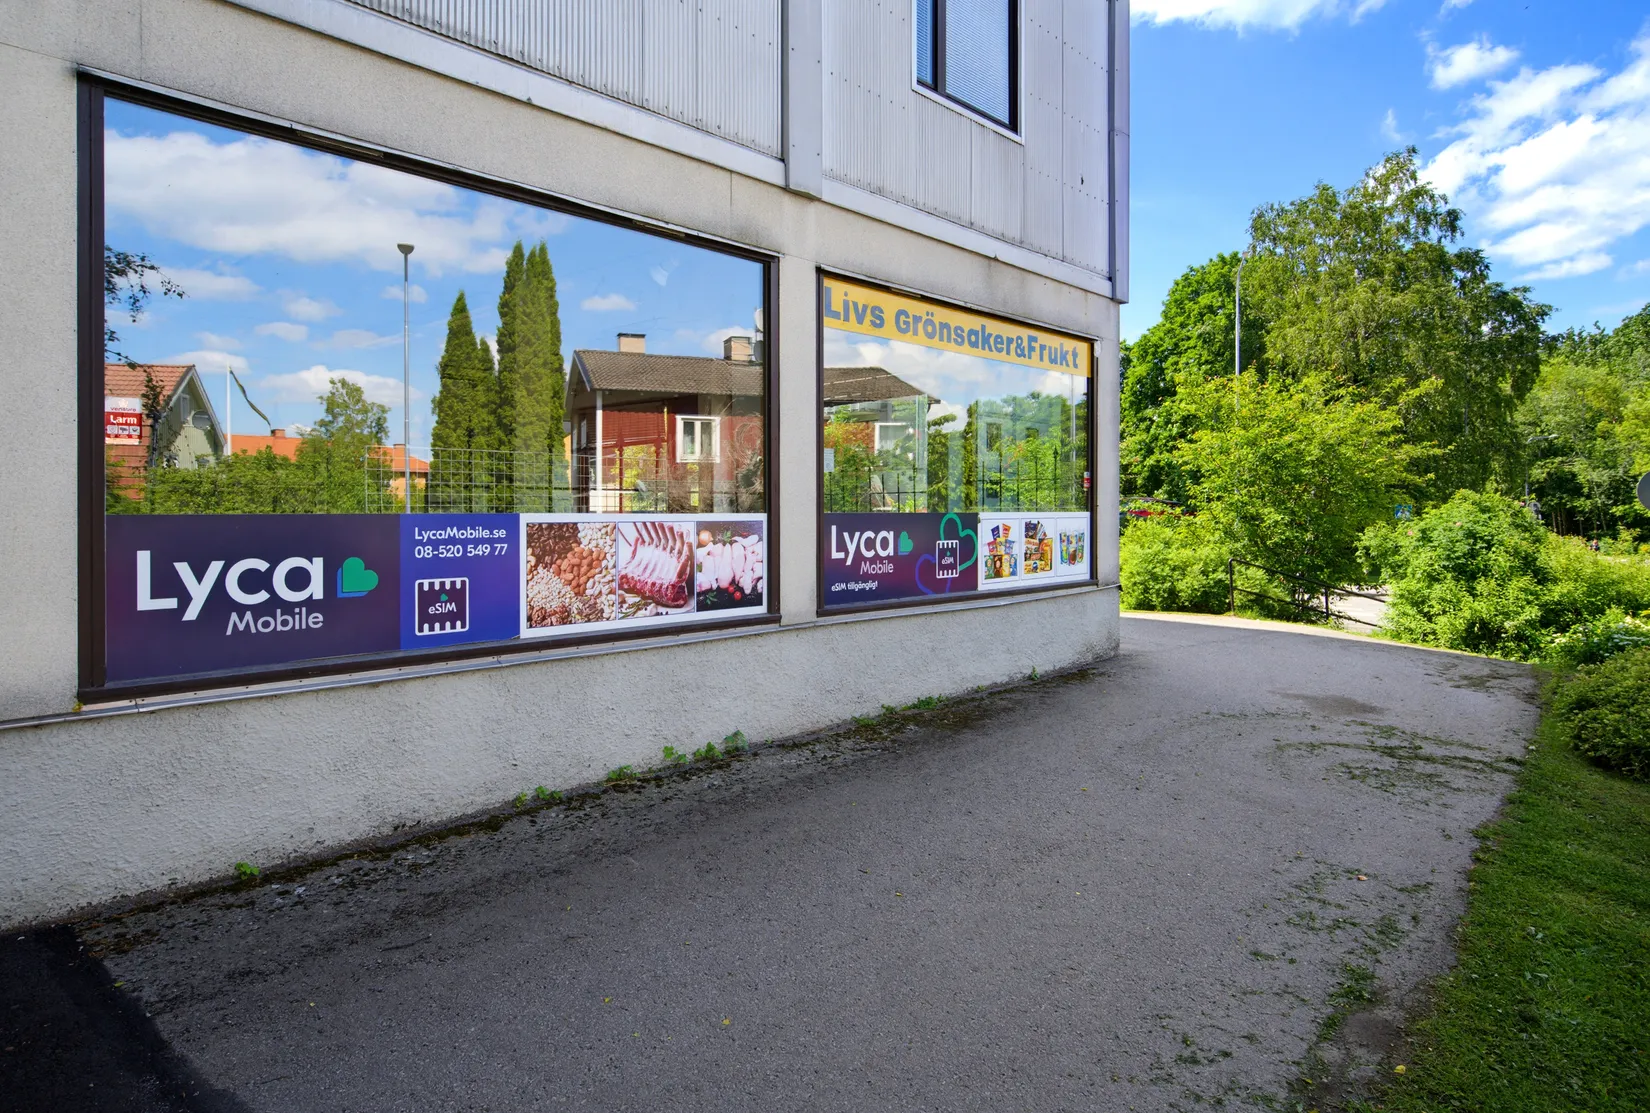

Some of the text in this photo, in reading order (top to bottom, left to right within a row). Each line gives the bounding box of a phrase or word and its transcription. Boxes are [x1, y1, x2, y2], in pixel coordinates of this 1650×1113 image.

[824, 286, 1079, 369] Livs Grönsaker&Frukt
[110, 415, 137, 424] Larm
[415, 526, 507, 543] LycaMobile.se
[415, 543, 508, 559] 08-520 549 77
[831, 525, 894, 566] Lyca
[860, 560, 894, 575] Mobile
[136, 550, 324, 621] Lyca
[831, 580, 878, 592] eSIM tillgängligt
[428, 602, 457, 614] eSIM
[226, 607, 324, 635] Mobile
